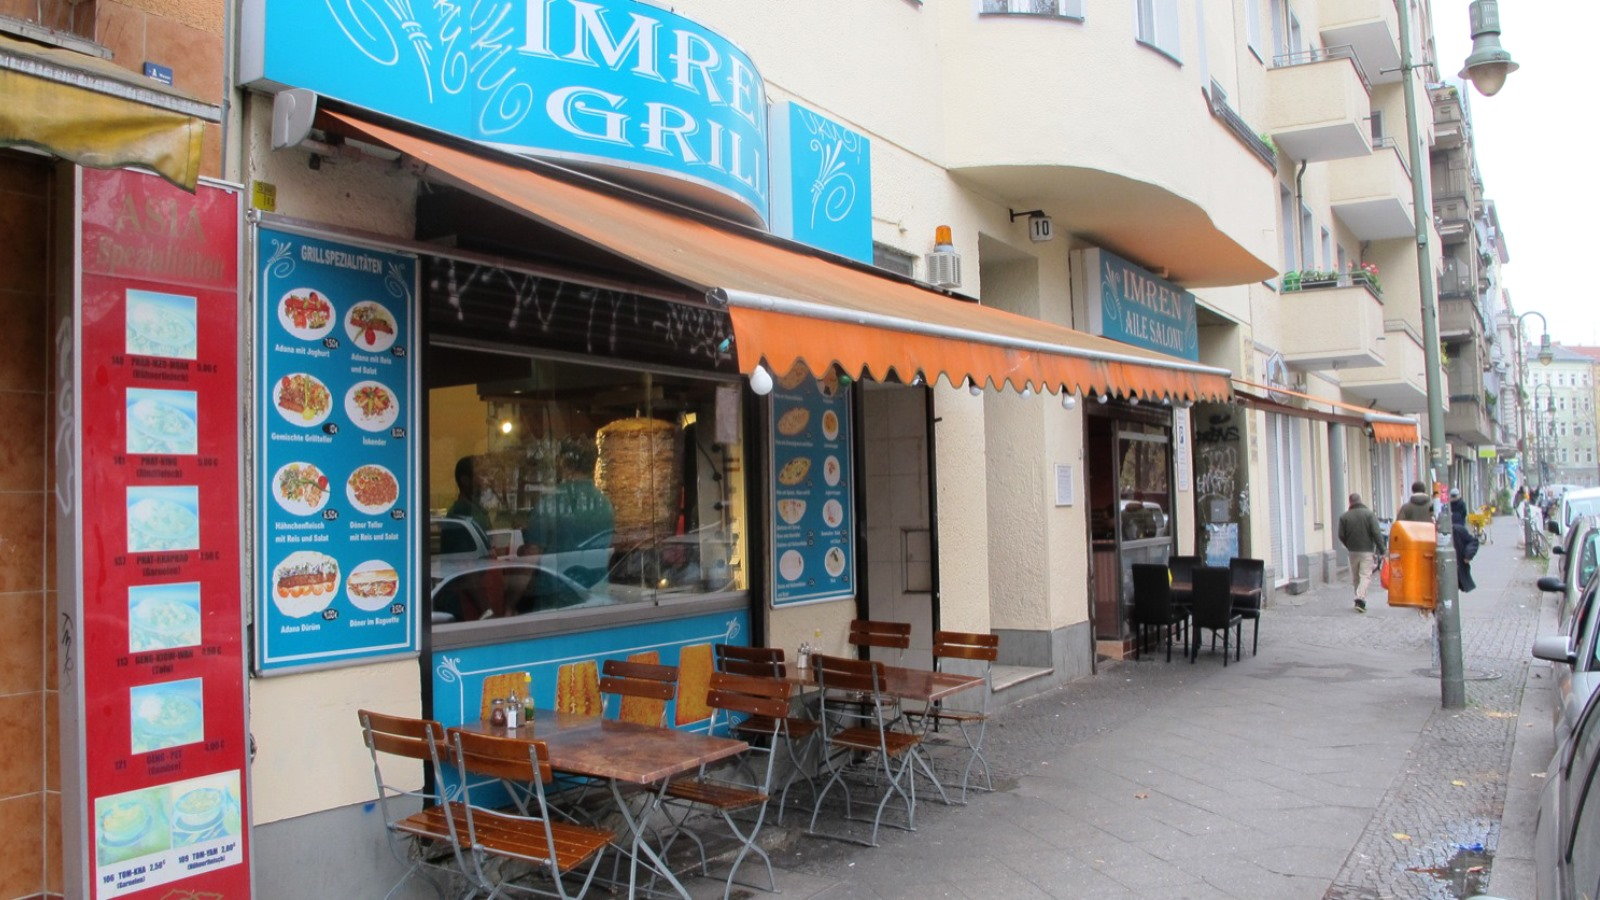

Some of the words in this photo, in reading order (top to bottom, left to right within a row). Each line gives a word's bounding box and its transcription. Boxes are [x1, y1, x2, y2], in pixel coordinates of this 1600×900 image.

[116, 193, 206, 244] ASIA
[1034, 219, 1050, 237] 10
[301, 244, 383, 275] GRILLSPEZIALITÄTEN
[1122, 268, 1182, 320] IMREN
[1125, 310, 1148, 340] AILE
[1149, 319, 1184, 352] SALONU
[275, 344, 295, 355] Adana
[296, 347, 306, 356] mit
[307, 347, 330, 359] Joghurt
[351, 352, 370, 364] Adana
[370, 355, 380, 364] mit
[351, 366, 362, 374] und
[363, 367, 377, 376] Salat
[271, 432, 304, 443] Gemischte
[304, 434, 332, 444] Grillteller
[276, 521, 325, 530] Hähnchenfleisch
[350, 520, 366, 529] Döner
[368, 520, 384, 529] Teller
[276, 534, 286, 543] mit
[287, 534, 300, 543] Reis
[302, 534, 312, 542] und
[314, 534, 329, 542] Salat
[350, 534, 360, 542] mit
[385, 532, 399, 540] Salat
[350, 619, 366, 628] Döner
[367, 618, 374, 626] im
[375, 616, 400, 627] Baguette
[280, 625, 300, 634] Adana
[301, 624, 321, 632] Dürüm
[192, 848, 218, 860] TOM-YAM
[118, 866, 146, 880] TOM-KHA
[116, 876, 146, 890] (Garnelen)
